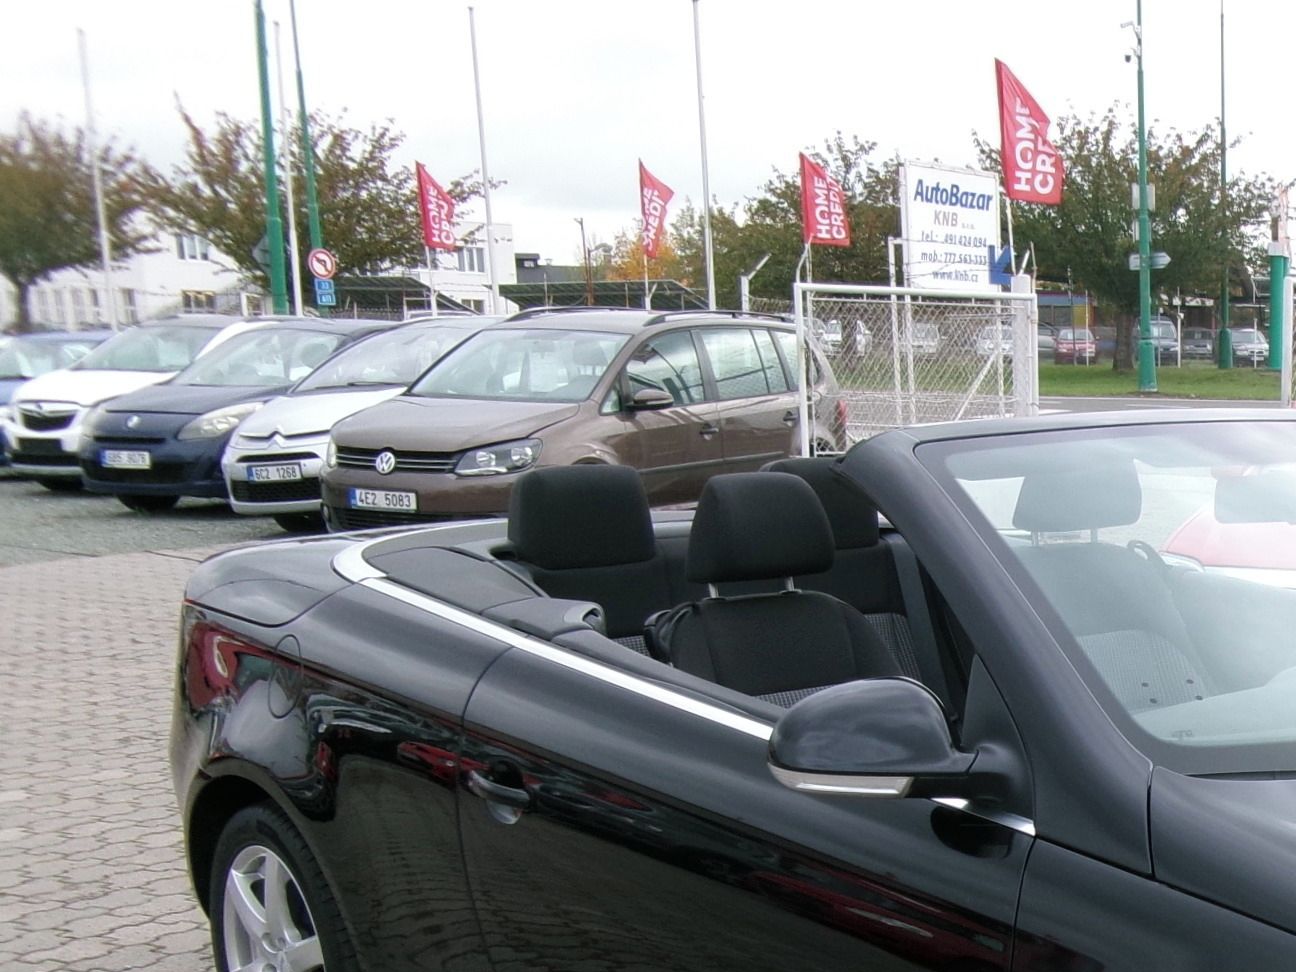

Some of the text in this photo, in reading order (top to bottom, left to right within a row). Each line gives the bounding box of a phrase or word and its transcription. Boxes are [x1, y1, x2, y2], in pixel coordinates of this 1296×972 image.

[914, 179, 993, 211] AutoBazar
[814, 176, 831, 239] HOME
[933, 209, 958, 227] KNB
[255, 466, 297, 480] 6C2 1268
[359, 491, 411, 507] 4E2 5083
